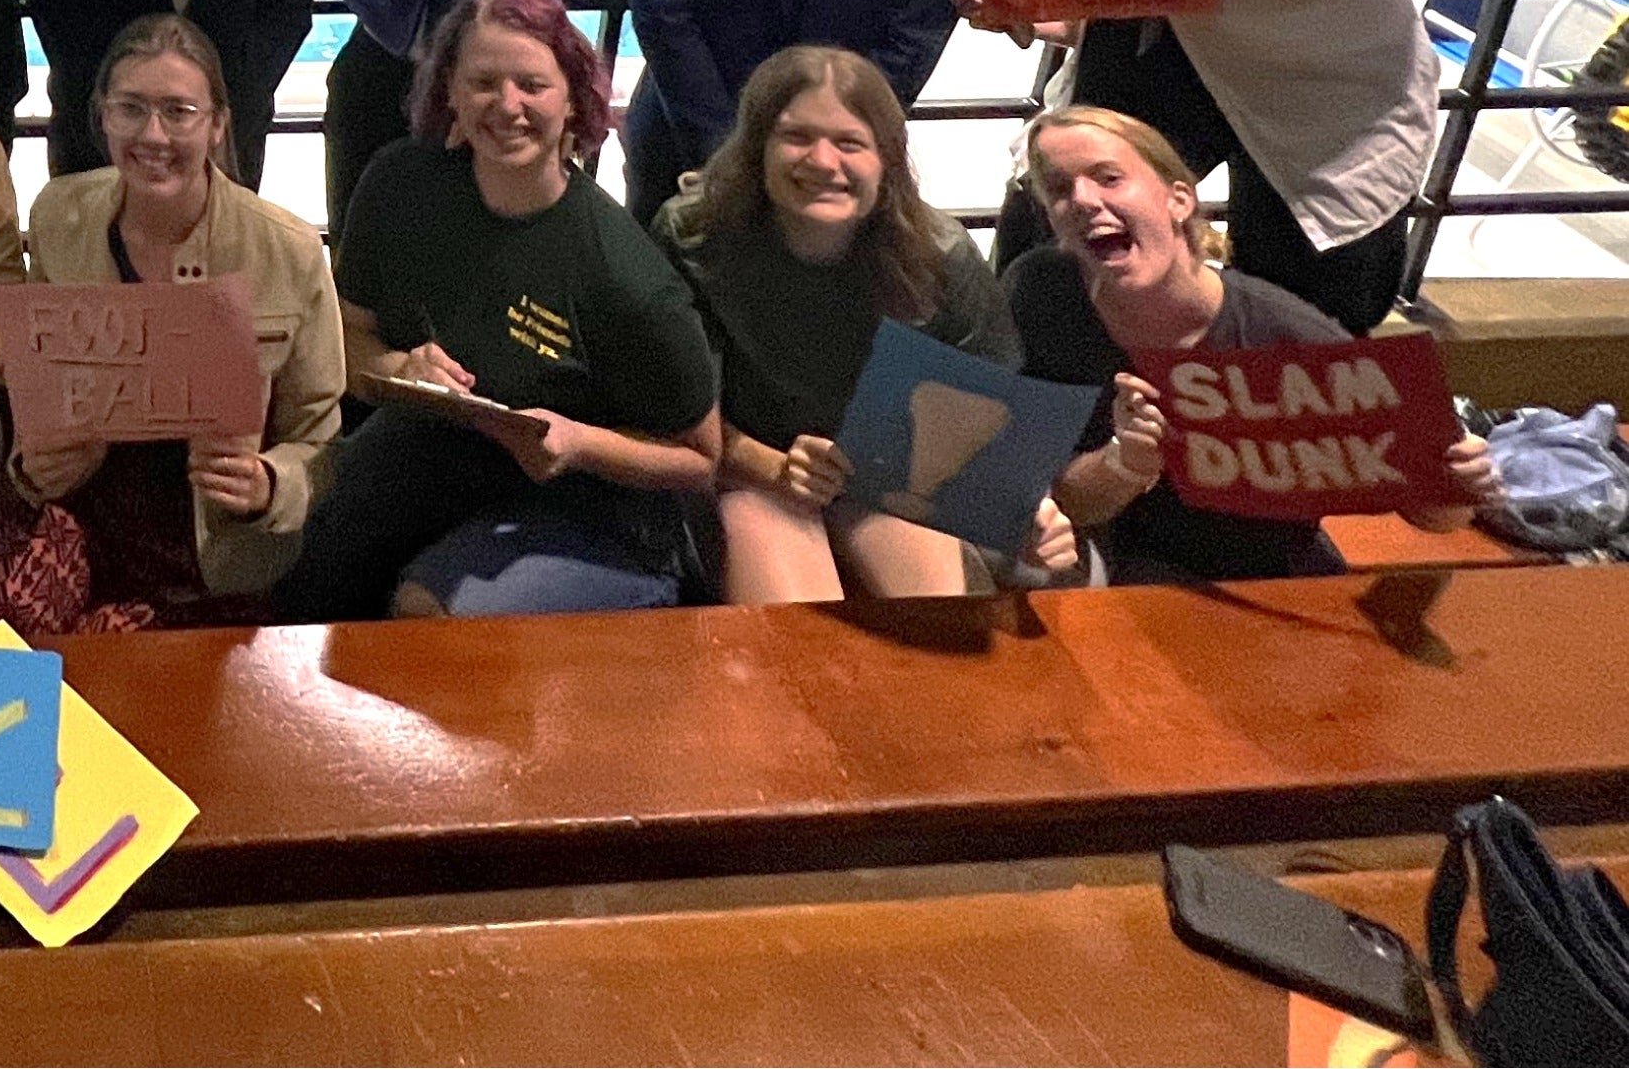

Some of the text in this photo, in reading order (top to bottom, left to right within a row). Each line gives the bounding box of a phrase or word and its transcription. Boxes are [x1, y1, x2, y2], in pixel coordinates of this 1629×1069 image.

[64, 372, 218, 427] BALL
[1170, 357, 1403, 420] SLAM
[1185, 430, 1409, 493] DUNK
